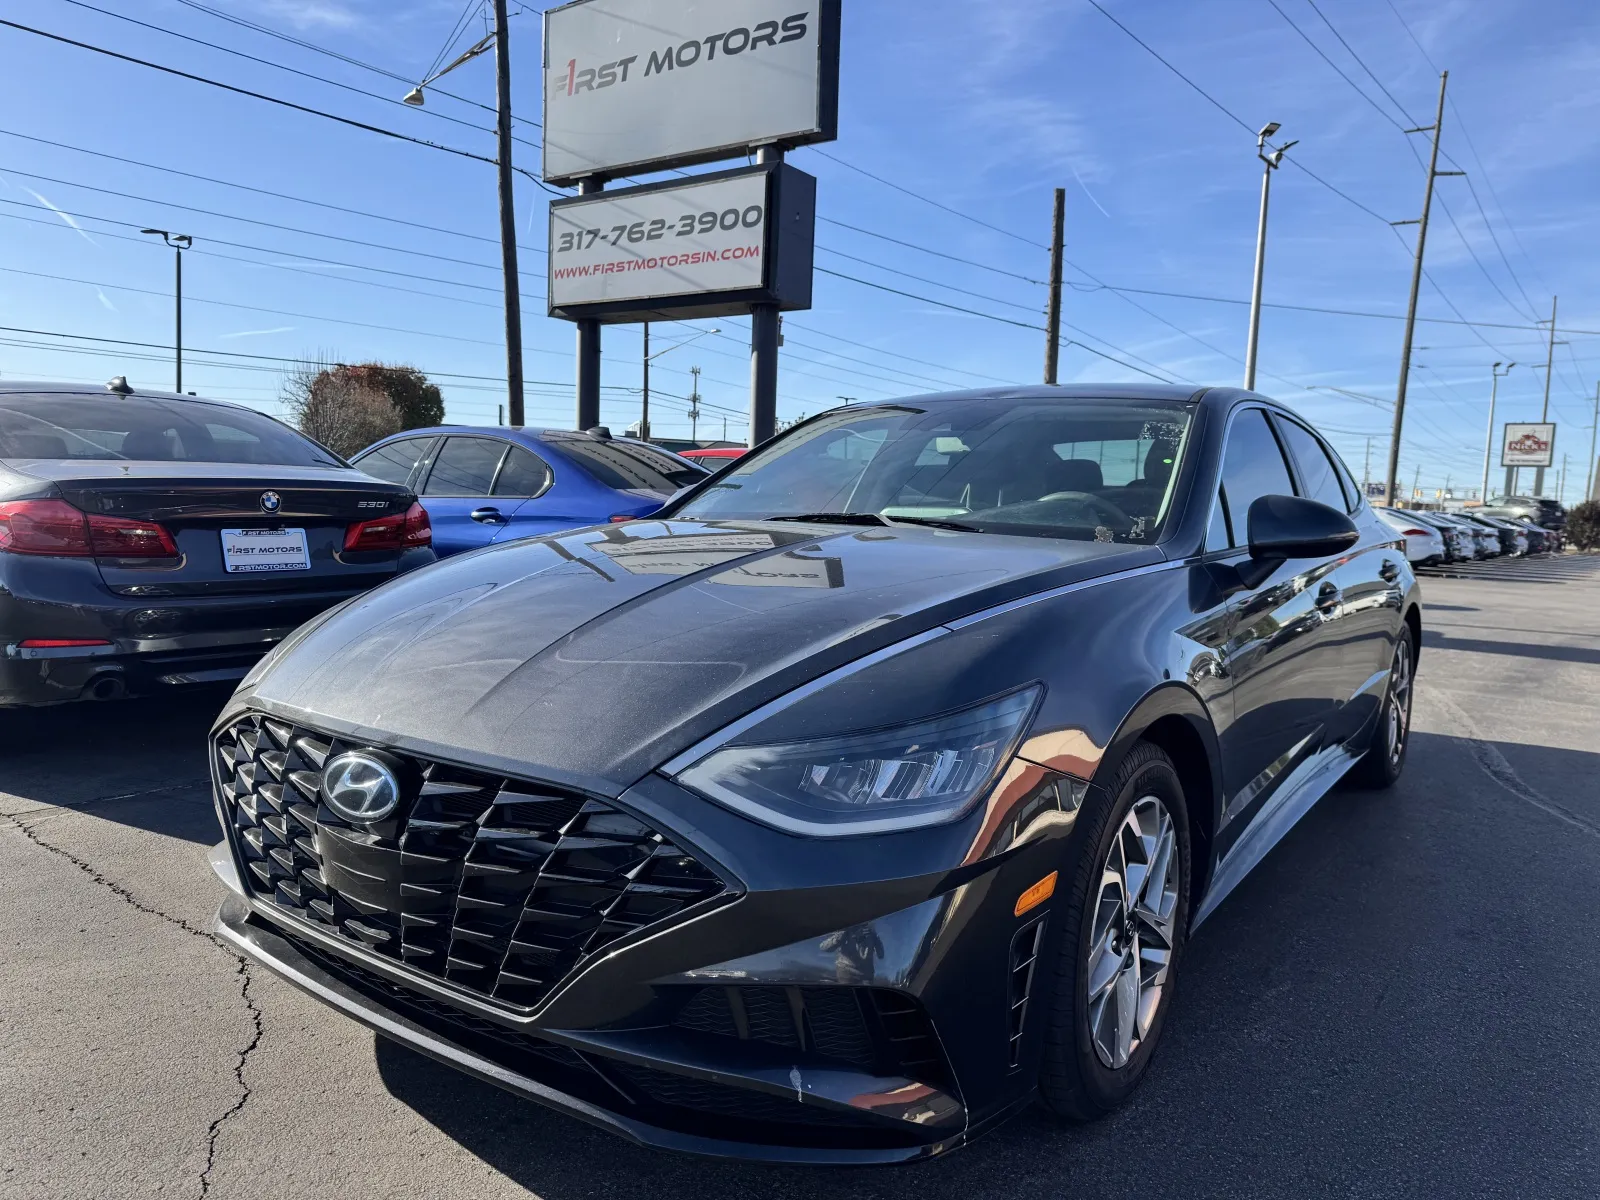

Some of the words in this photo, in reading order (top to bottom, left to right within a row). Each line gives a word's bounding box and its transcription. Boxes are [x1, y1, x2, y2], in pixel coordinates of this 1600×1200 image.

[644, 12, 808, 76] MOTORS
[557, 205, 762, 252] 317-762-3900
[554, 245, 760, 280] WWW.FIRSTMOTORSIN.COM
[258, 546, 303, 554] MOTORS
